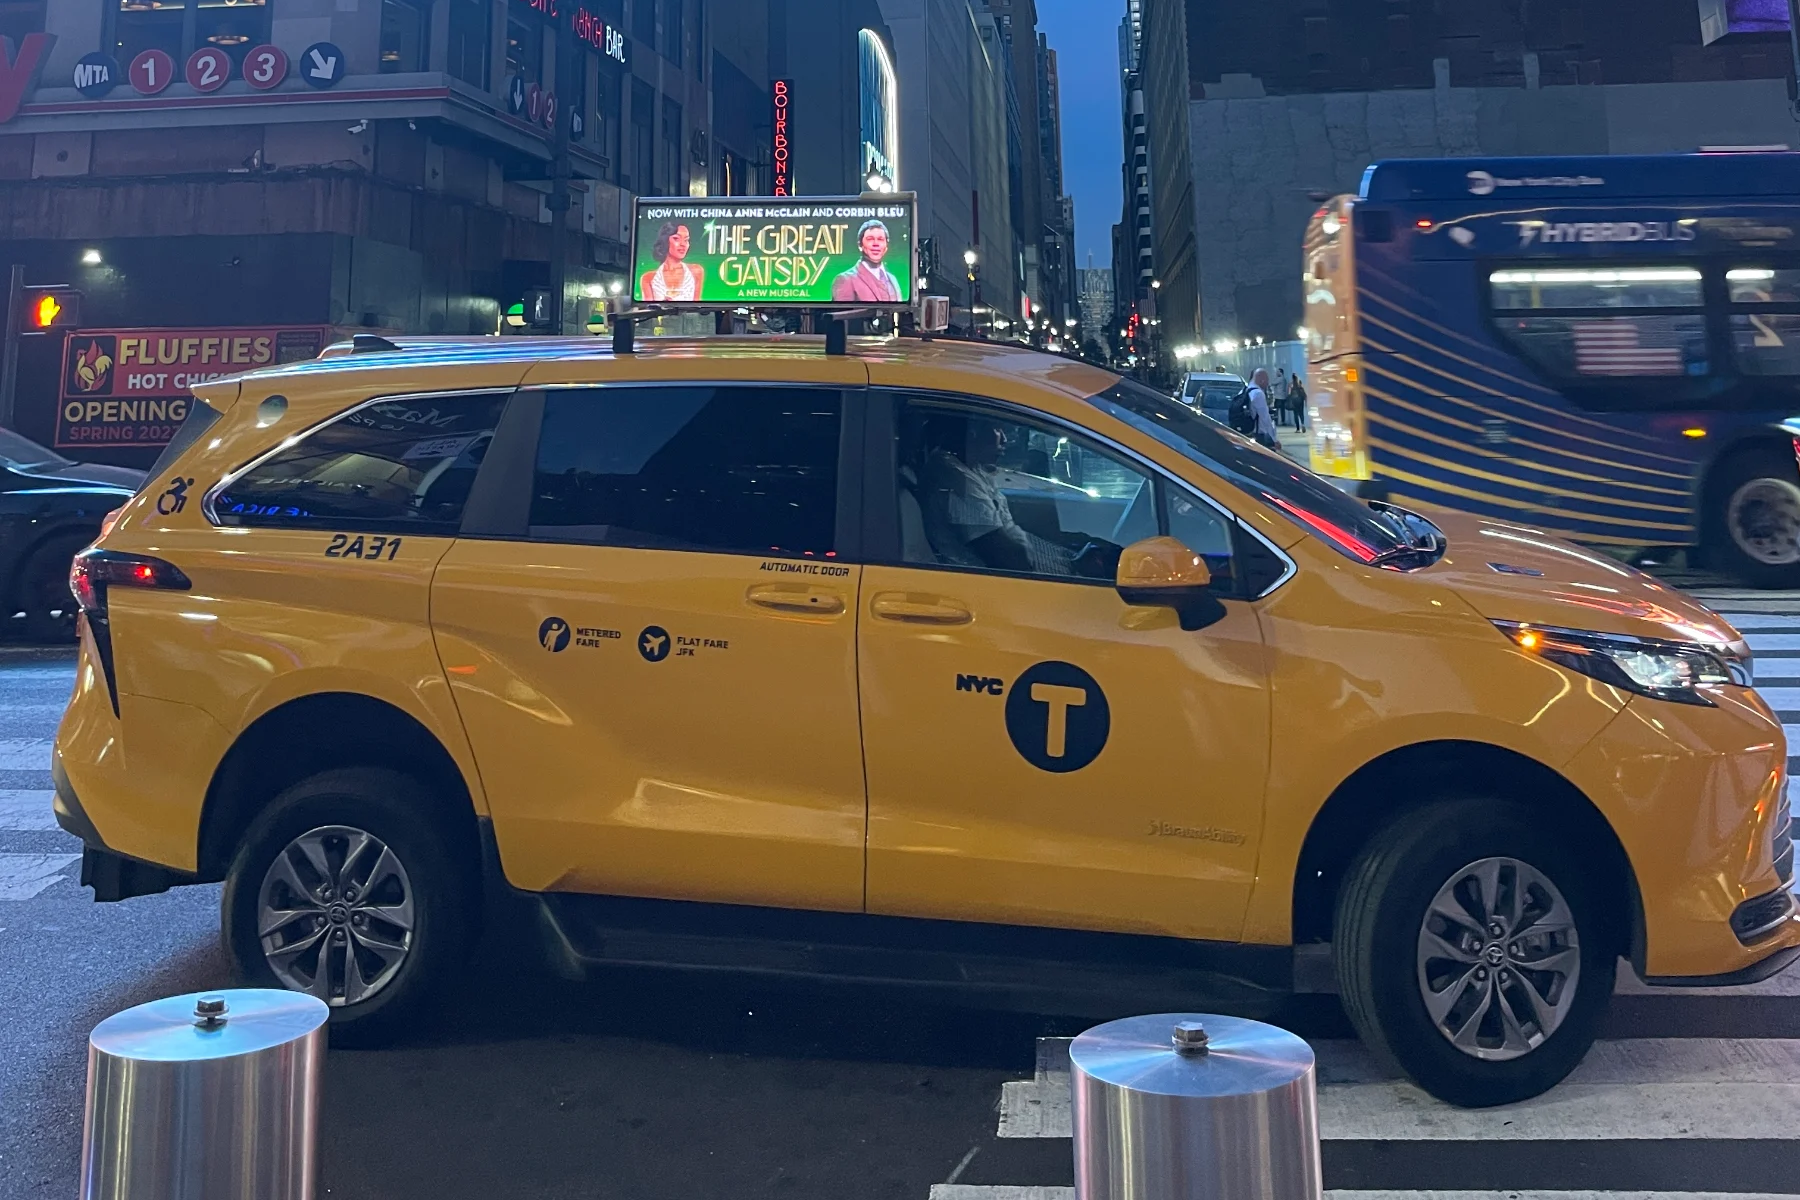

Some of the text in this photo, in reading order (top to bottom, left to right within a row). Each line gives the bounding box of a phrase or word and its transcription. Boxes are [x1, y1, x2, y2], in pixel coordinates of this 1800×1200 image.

[605, 25, 626, 63] BAR
[73, 53, 276, 88] MTA 1 2 3
[775, 81, 788, 173] BOURBON
[775, 175, 786, 185] &
[647, 208, 904, 218] NOW WITH CHINA ANNE McCLAIN AND CORBIN BLEU
[706, 224, 848, 255] THE GREAT
[719, 257, 830, 286] GATSBY
[737, 289, 811, 297] A NEW MUSICAL
[119, 337, 271, 365] FLUFFIES
[127, 374, 168, 390] HOT
[64, 400, 187, 423] OPENING
[69, 426, 133, 440] SPRING
[325, 534, 402, 561] 2A31
[759, 562, 850, 577] AUTOMATIC DOOR
[576, 627, 621, 639] METERED
[576, 637, 600, 648] FARE
[676, 636, 729, 649] FLAT FARE
[675, 647, 695, 656] JFK
[956, 673, 1003, 695] NYC
[1031, 683, 1086, 757] T
